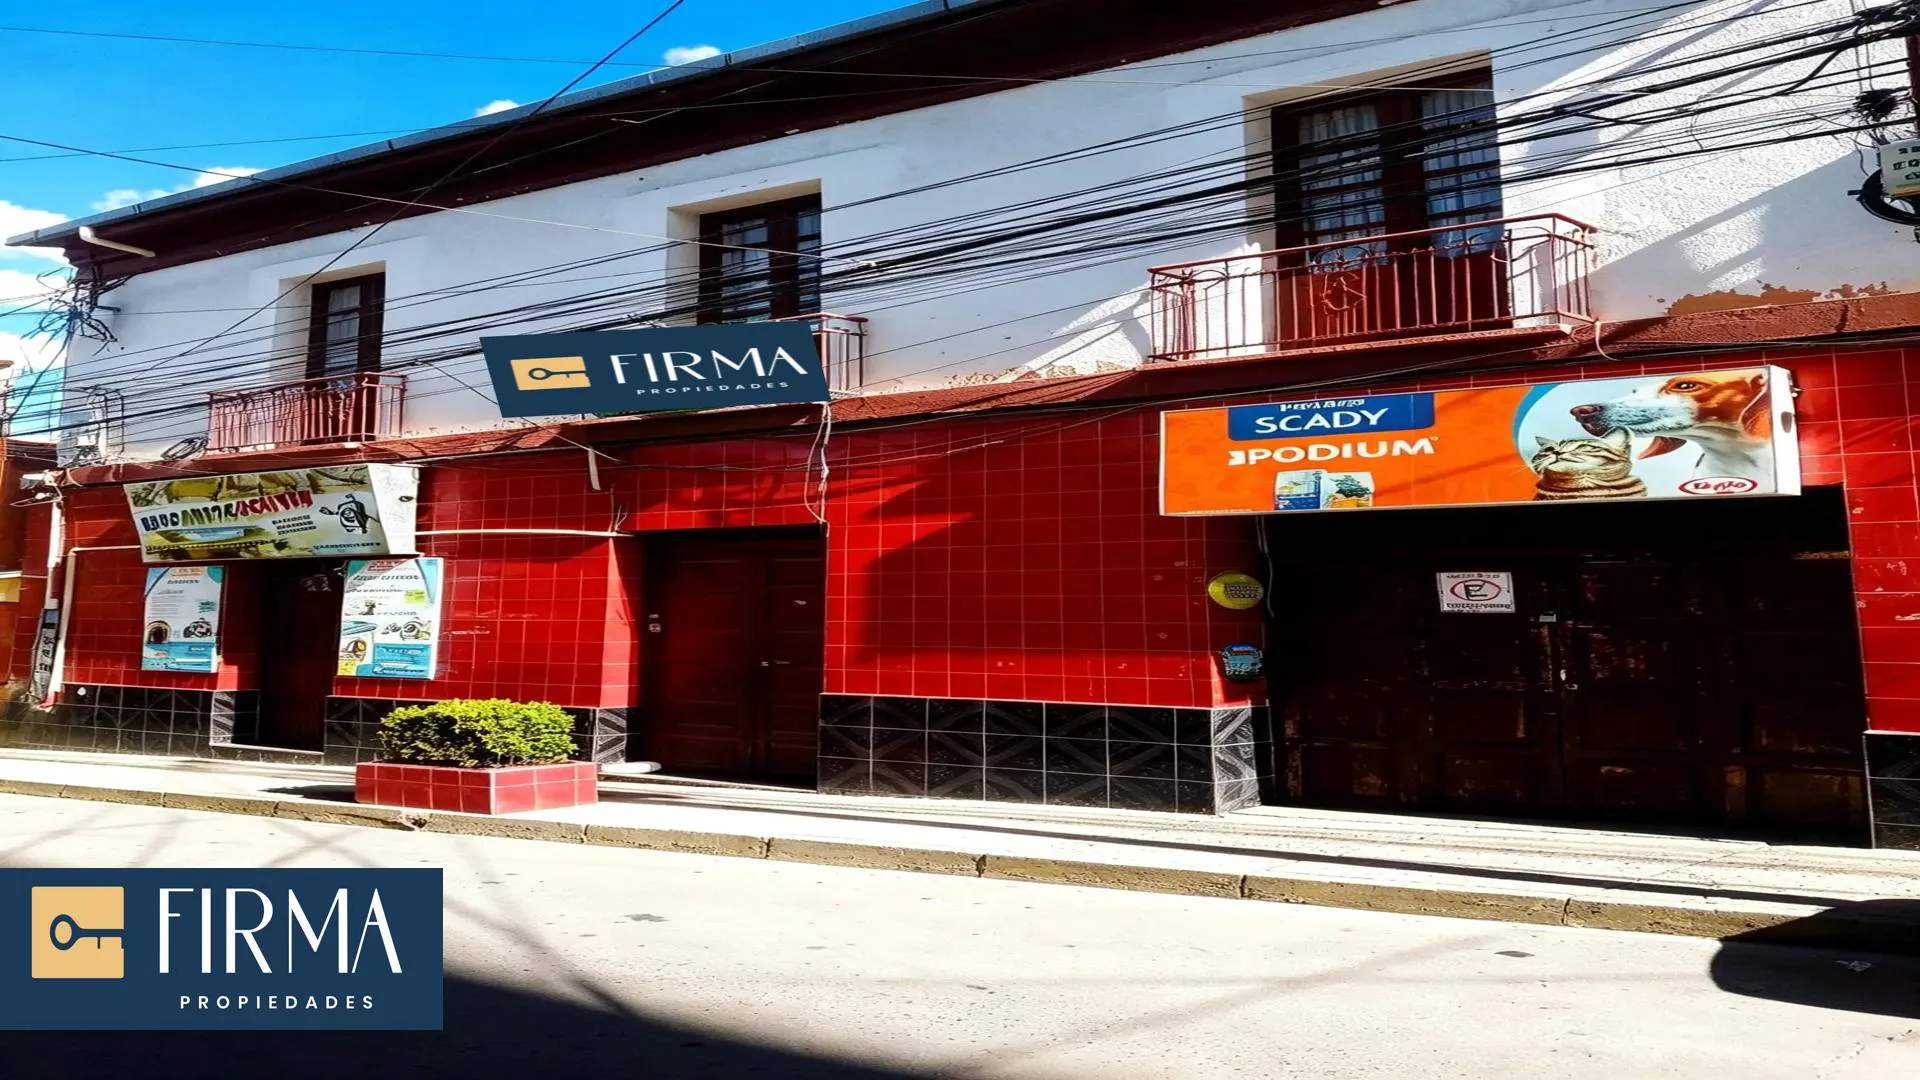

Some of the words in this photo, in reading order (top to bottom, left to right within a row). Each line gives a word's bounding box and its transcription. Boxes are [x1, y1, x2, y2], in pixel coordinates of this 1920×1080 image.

[610, 346, 808, 384] FIRMA
[636, 381, 790, 396] PROPIEDADES
[1255, 407, 1389, 434] SCADY
